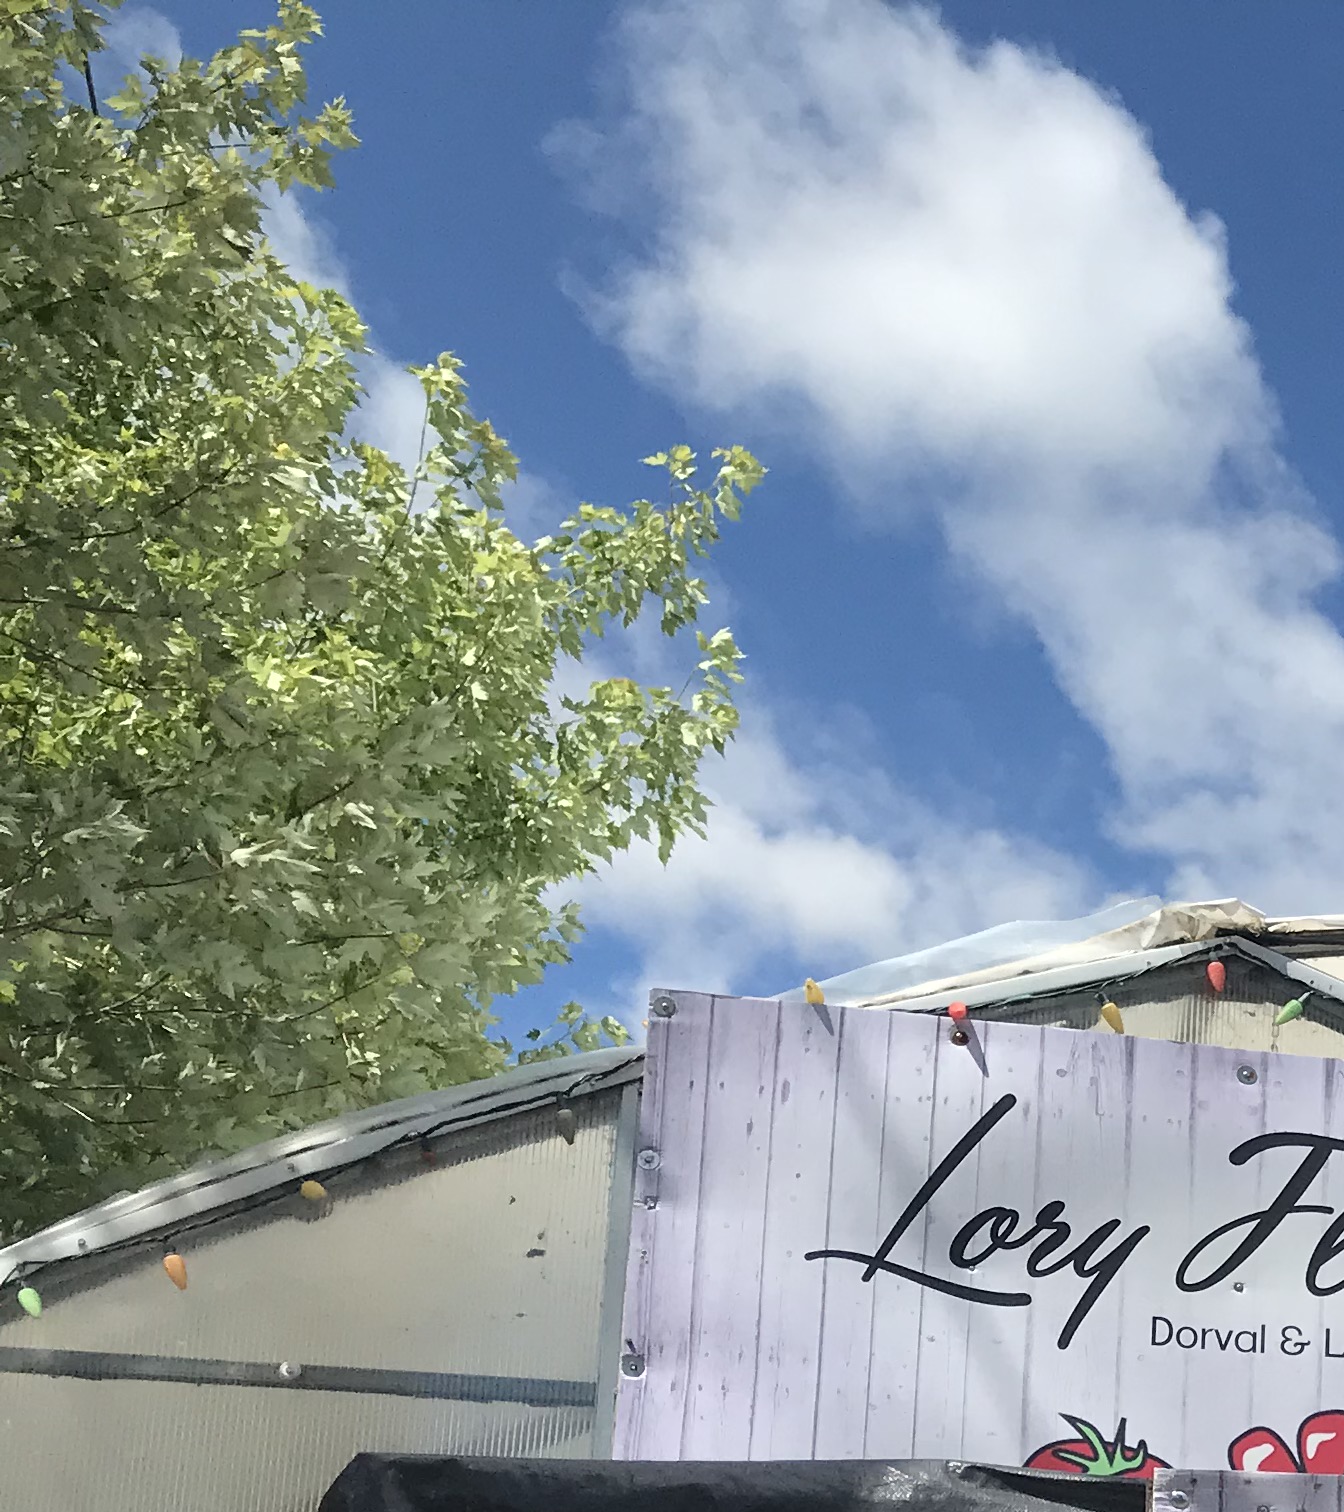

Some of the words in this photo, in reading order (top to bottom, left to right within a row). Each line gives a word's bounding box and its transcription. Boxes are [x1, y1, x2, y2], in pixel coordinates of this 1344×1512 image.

[804, 1093, 1151, 1350] Lory
[1150, 1315, 1267, 1357] Dorval
[1279, 1324, 1312, 1358] &
